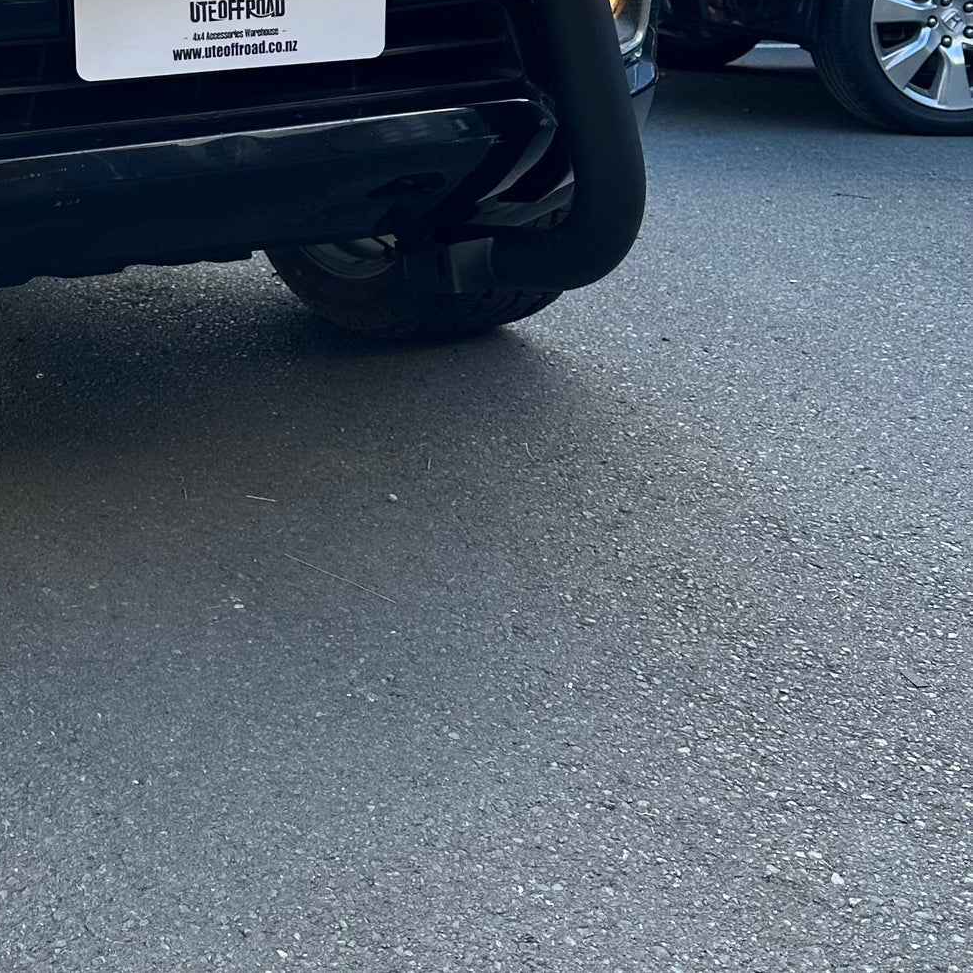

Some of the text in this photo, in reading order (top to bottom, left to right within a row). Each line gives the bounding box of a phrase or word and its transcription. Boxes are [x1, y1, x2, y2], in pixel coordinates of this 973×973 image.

[206, 28, 244, 41] Accessories
[245, 26, 279, 39] Warehouse
[173, 40, 298, 61] www.uteoffroad.co.nz
